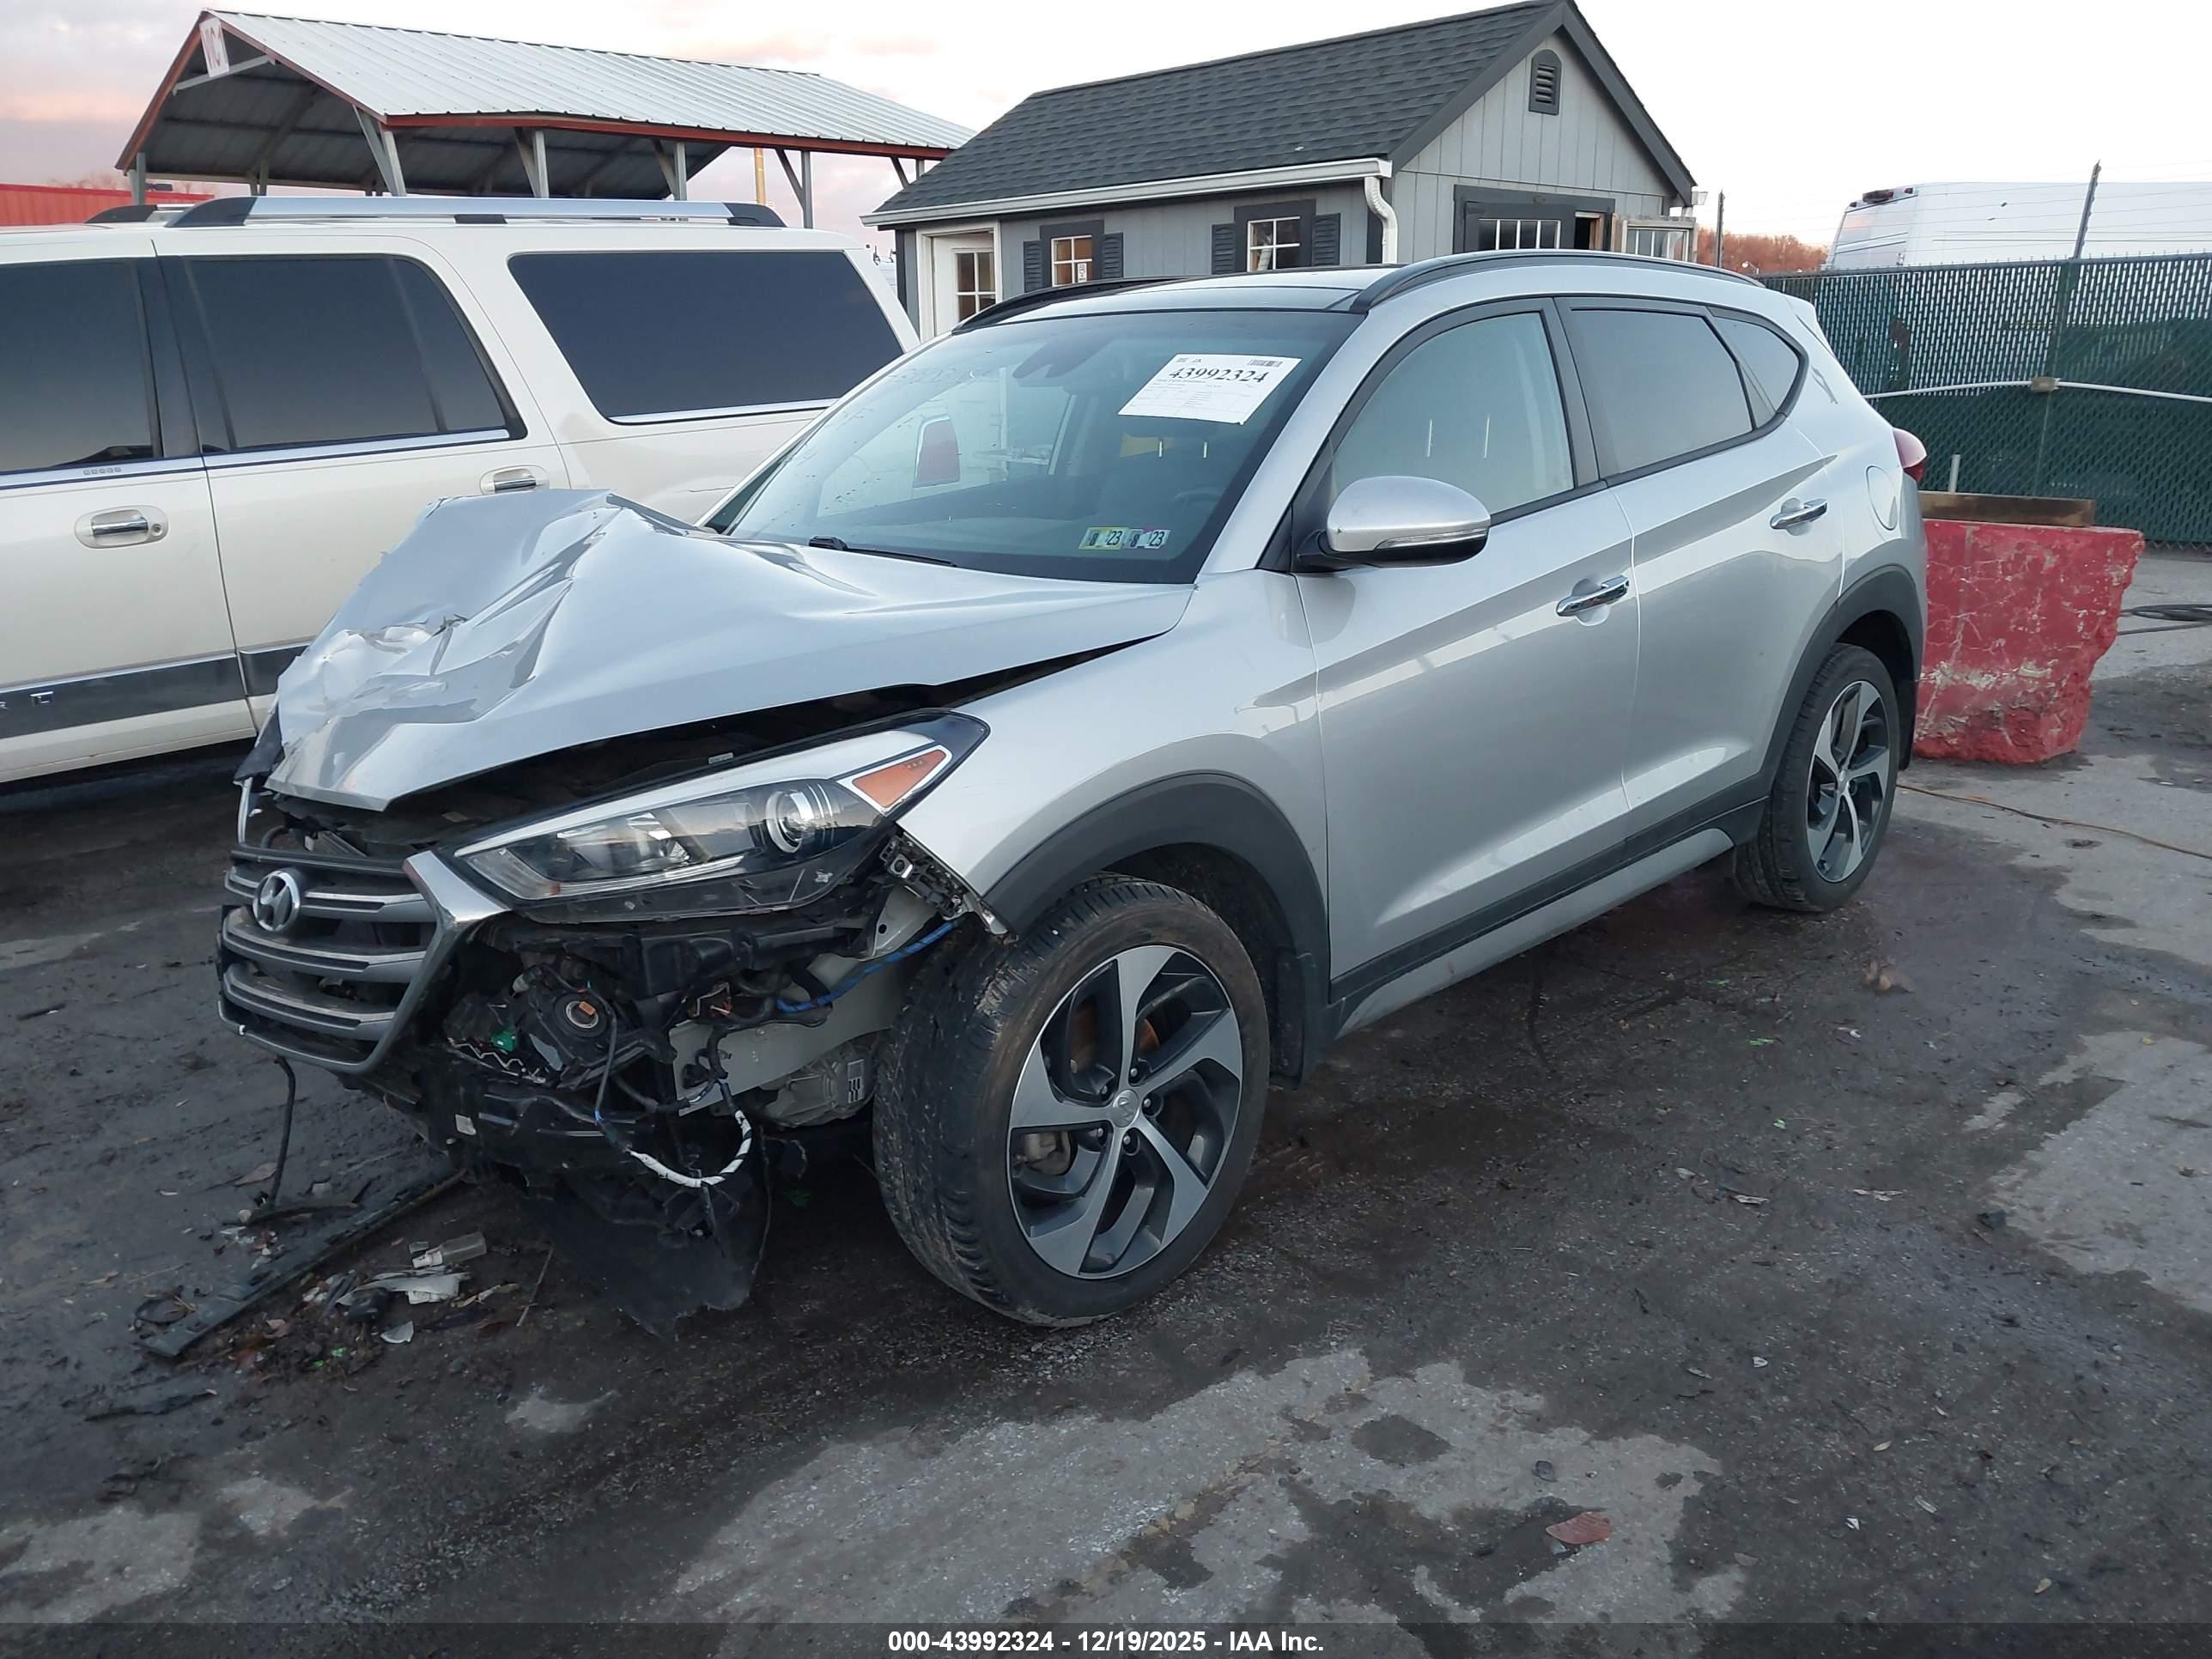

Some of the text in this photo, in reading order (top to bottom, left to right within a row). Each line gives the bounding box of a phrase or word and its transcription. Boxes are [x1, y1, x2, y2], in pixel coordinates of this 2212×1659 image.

[1169, 368, 1270, 383] 43992324
[1106, 531, 1123, 546] 23
[1148, 531, 1165, 547] 23
